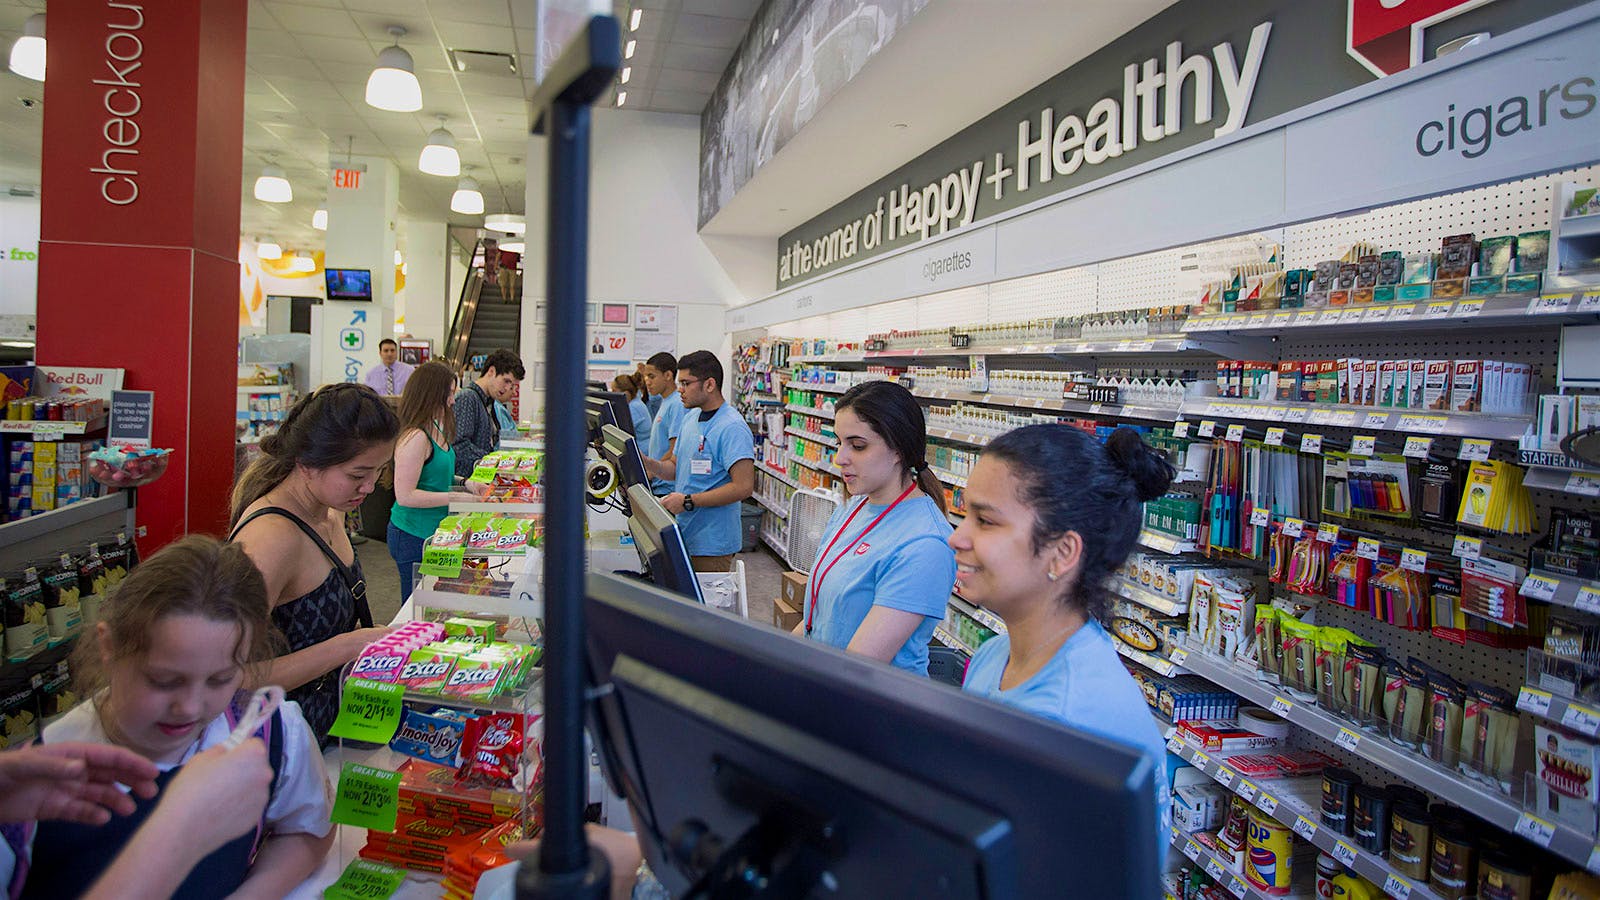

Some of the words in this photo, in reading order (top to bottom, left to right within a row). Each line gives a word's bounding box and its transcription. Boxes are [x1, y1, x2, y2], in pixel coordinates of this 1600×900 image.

[89, 0, 145, 205] checkou
[1416, 77, 1597, 159] cigars
[780, 249, 791, 282] at
[791, 240, 812, 277] the
[813, 218, 863, 270] corner
[863, 196, 885, 250] of
[888, 160, 983, 241] Happy
[1017, 21, 1272, 191] Healthy
[335, 169, 361, 189] EXIT
[922, 250, 972, 281] cigarettes
[1320, 363, 1333, 371] FIN
[1430, 363, 1445, 374] FIN
[1458, 363, 1475, 373] FIN
[46, 371, 75, 385] Red
[76, 372, 103, 385] Bull
[1521, 451, 1566, 466] STARTER
[433, 533, 463, 544] Extra
[470, 530, 498, 542] Extra
[497, 533, 526, 546] Extra
[1120, 618, 1152, 643] CLASSIC
[355, 655, 403, 673] Extra
[401, 662, 448, 679] Extra
[354, 679, 378, 689] GREAT
[449, 668, 499, 687] Extra
[346, 703, 365, 715] NOW
[434, 732, 458, 752] Joy
[352, 765, 376, 776] GREAT
[375, 770, 394, 780] BUY!
[1544, 769, 1587, 798] PHILLIES
[343, 789, 361, 801] NOW
